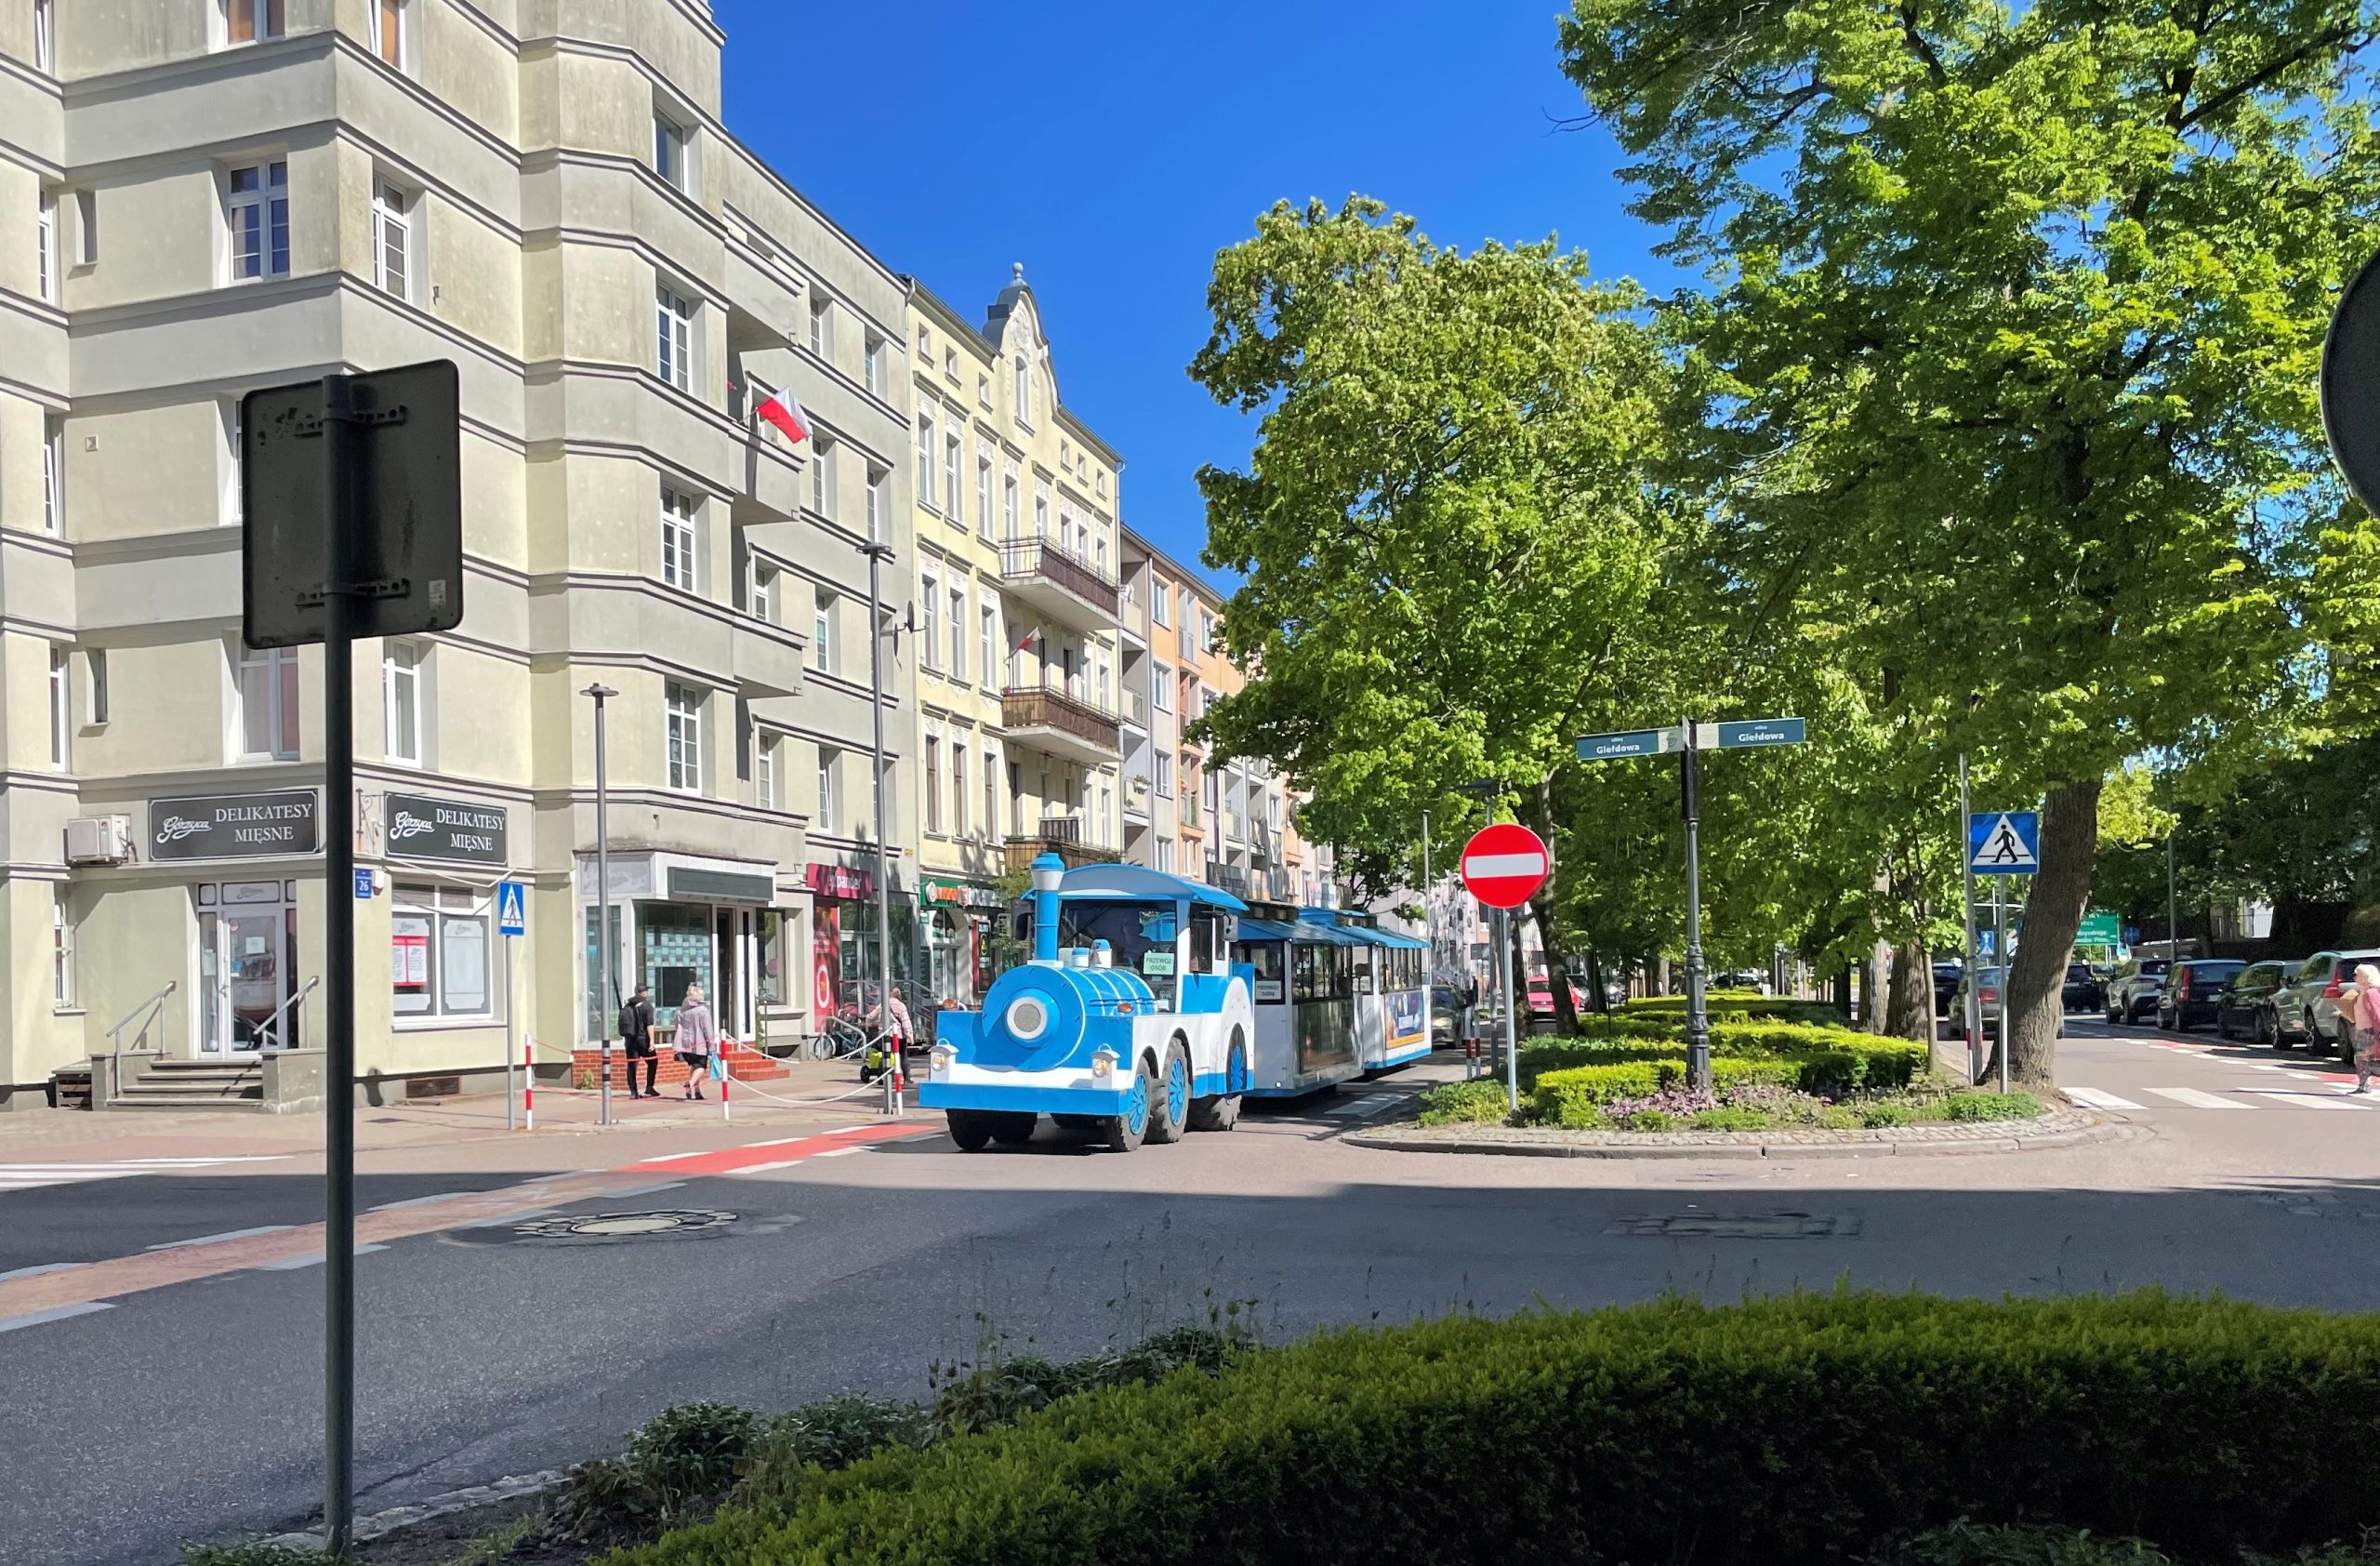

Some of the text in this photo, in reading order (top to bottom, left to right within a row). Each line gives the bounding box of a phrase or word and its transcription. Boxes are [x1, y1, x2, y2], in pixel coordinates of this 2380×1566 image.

[1739, 732, 1785, 742] Giełdowa
[215, 803, 312, 822] DELIKATESY
[436, 808, 505, 830] DELIKATESY
[234, 827, 294, 844] MIĘSNE
[451, 833, 493, 852] MIĘSNE
[359, 880, 369, 892] 26
